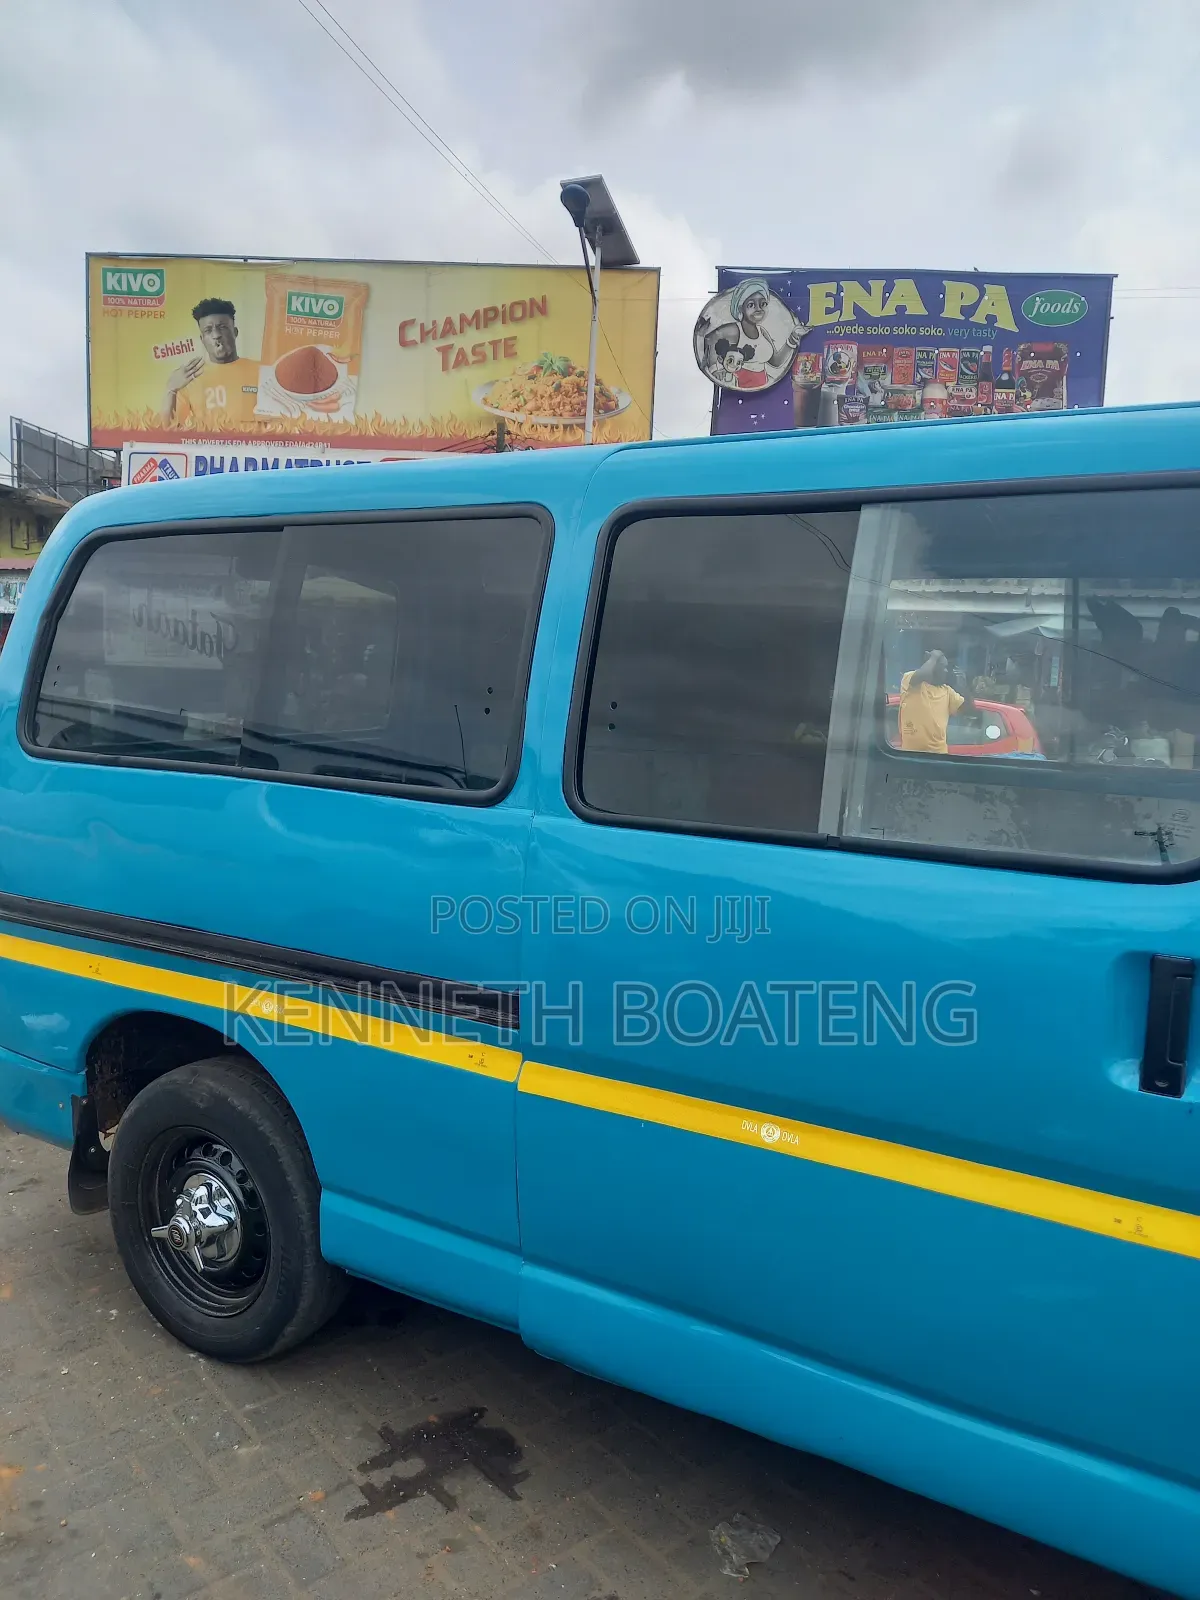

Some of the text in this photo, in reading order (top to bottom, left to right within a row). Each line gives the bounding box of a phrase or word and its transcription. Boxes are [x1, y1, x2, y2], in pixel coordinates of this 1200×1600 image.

[106, 271, 161, 293] KIVO
[107, 296, 161, 306] 100% NATURAL
[291, 295, 340, 316] KIVO
[807, 278, 1020, 333] ENA PA
[1028, 297, 1082, 318] foods
[103, 308, 166, 319] HOT PEPPER
[290, 316, 337, 328] 100% NATURAL
[284, 326, 341, 339] HOT PEPPER
[866, 325, 891, 336] soko
[893, 325, 918, 336] soko
[948, 328, 970, 339] very
[972, 327, 998, 340] tasty
[435, 335, 518, 373] TASTE
[1019, 359, 1061, 371] ENA PA
[204, 385, 227, 410] 20
[197, 438, 225, 447] ADVERT
[248, 440, 284, 448] APPROVED
[132, 460, 156, 484] PHARMA
[163, 463, 179, 480] TRUS
